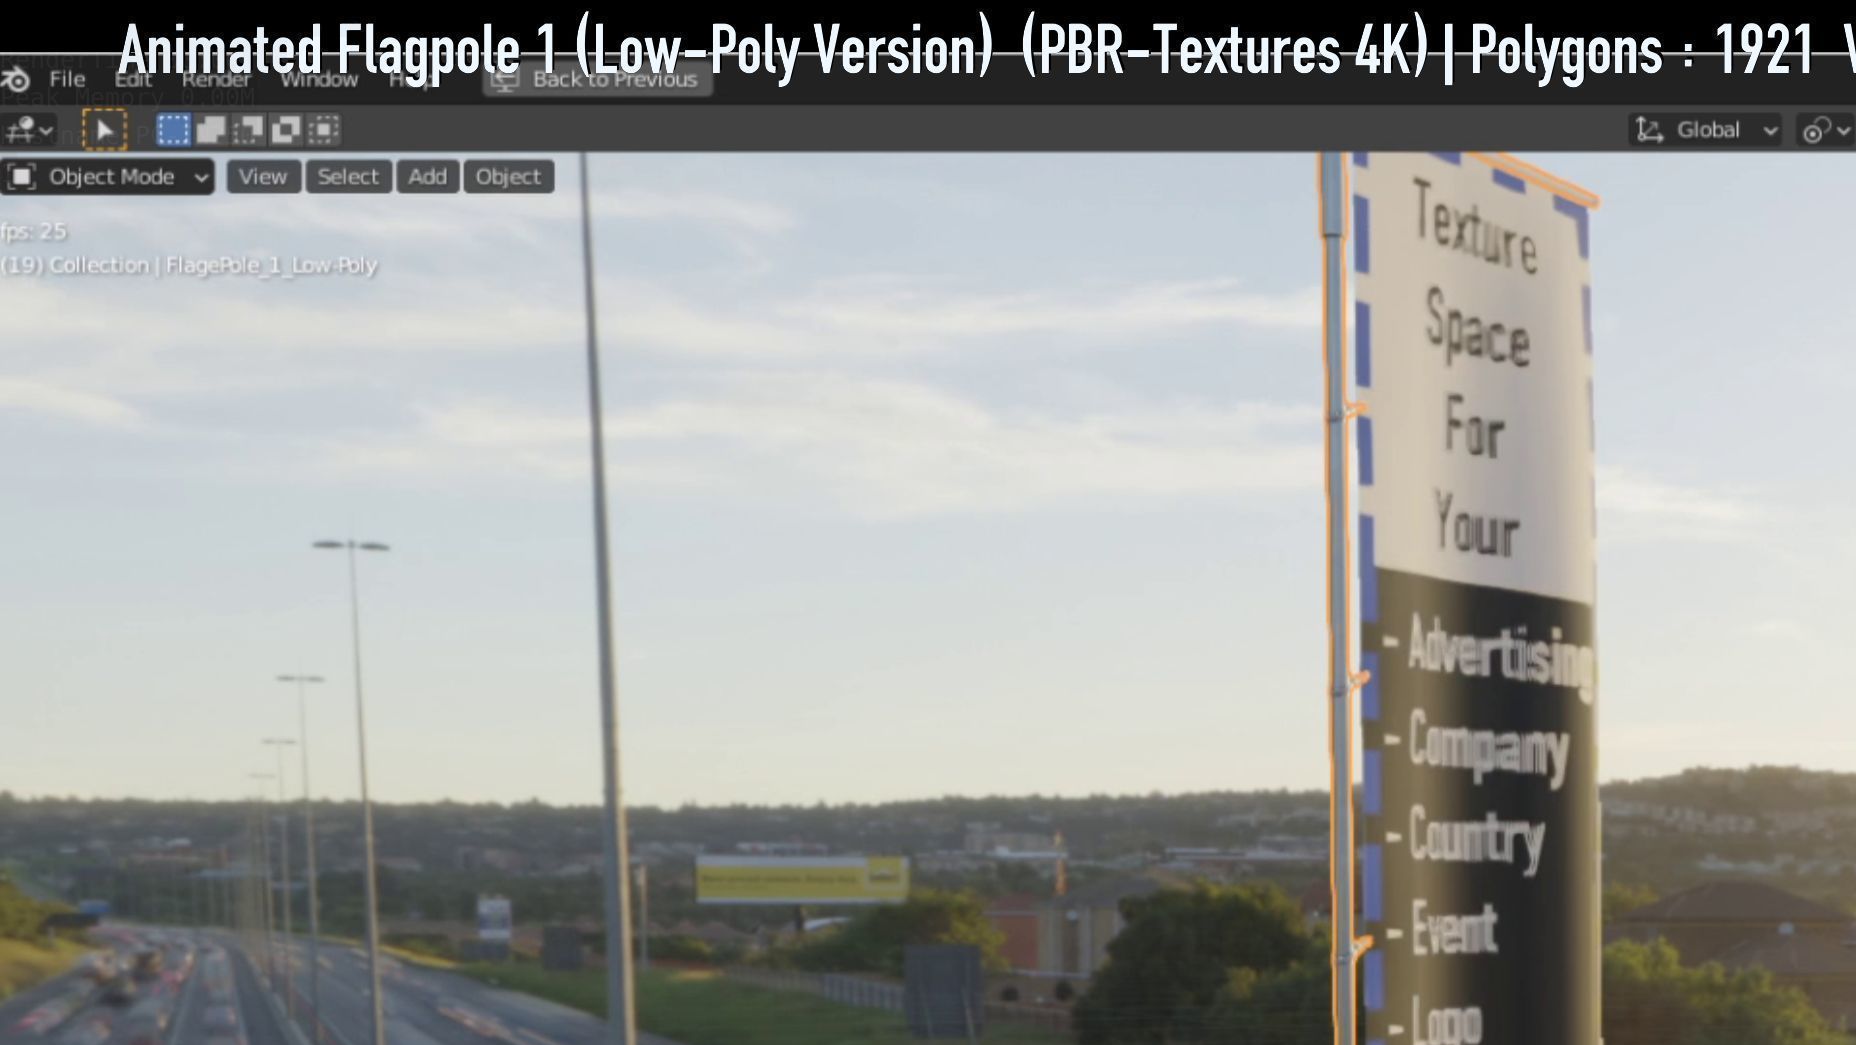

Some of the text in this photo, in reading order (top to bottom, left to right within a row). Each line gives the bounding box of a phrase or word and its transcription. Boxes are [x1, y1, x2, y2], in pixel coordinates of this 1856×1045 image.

[50, 70, 359, 88] File Edit Render Window
[534, 70, 698, 88] Back to Previous
[1677, 120, 1741, 140] Global
[49, 168, 174, 188] Object Mode
[238, 167, 288, 186] View
[317, 167, 380, 186] Select
[408, 167, 447, 186] Add
[476, 167, 542, 188] Object
[0, 222, 67, 241] fps: 25
[1413, 177, 1538, 275] Texture
[0, 256, 44, 275] (19)
[50, 256, 150, 274] Collection
[166, 256, 379, 279] FlagePole_1_Low-Poly
[1427, 286, 1530, 368] Space
[1444, 394, 1505, 459] For
[1434, 488, 1519, 558] Your
[1409, 611, 1593, 706] Advertising
[1409, 708, 1570, 790] Company
[1410, 803, 1546, 877] Country
[1412, 899, 1498, 956] Event
